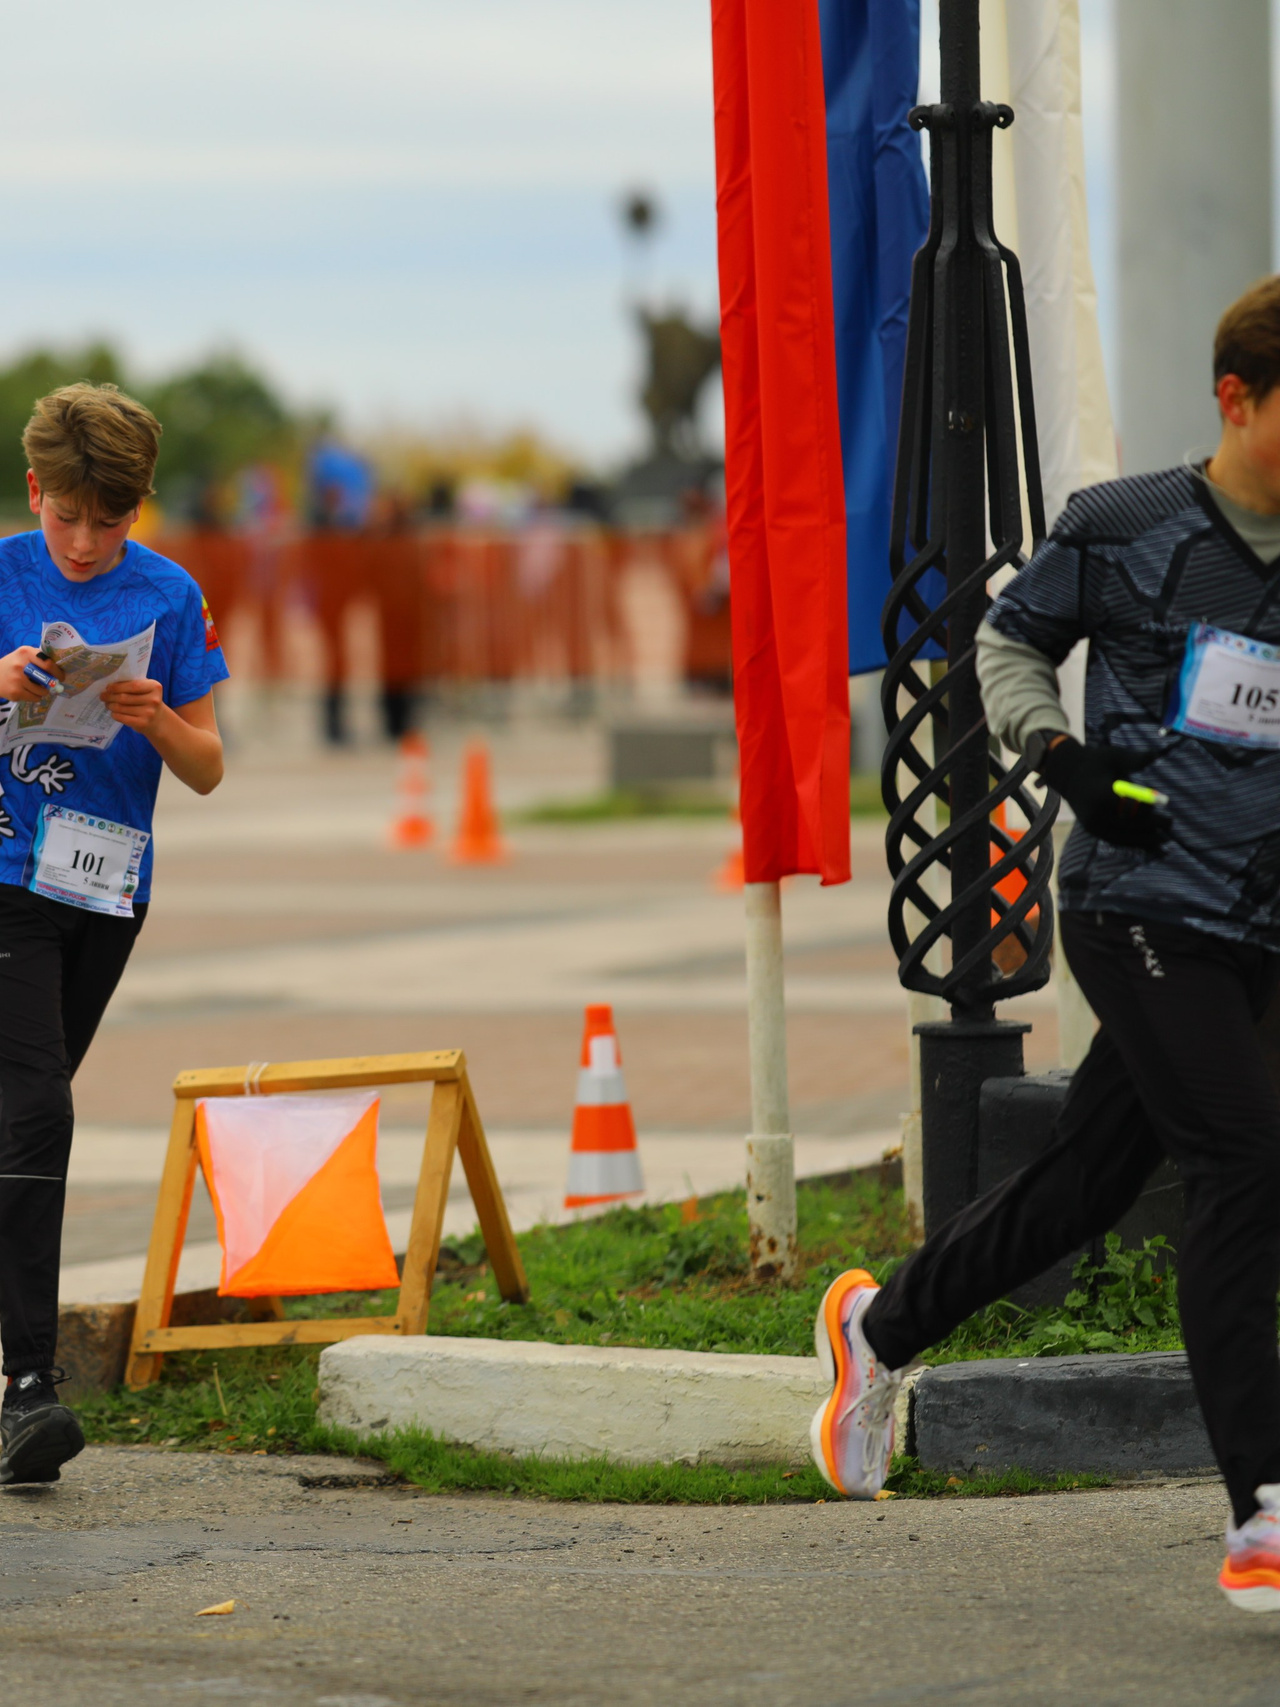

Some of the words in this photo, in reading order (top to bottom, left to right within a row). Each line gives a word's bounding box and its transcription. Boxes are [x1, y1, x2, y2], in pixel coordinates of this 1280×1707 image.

[1231, 683, 1279, 711] 105
[70, 849, 105, 876] 101
[83, 877, 89, 885] 5
